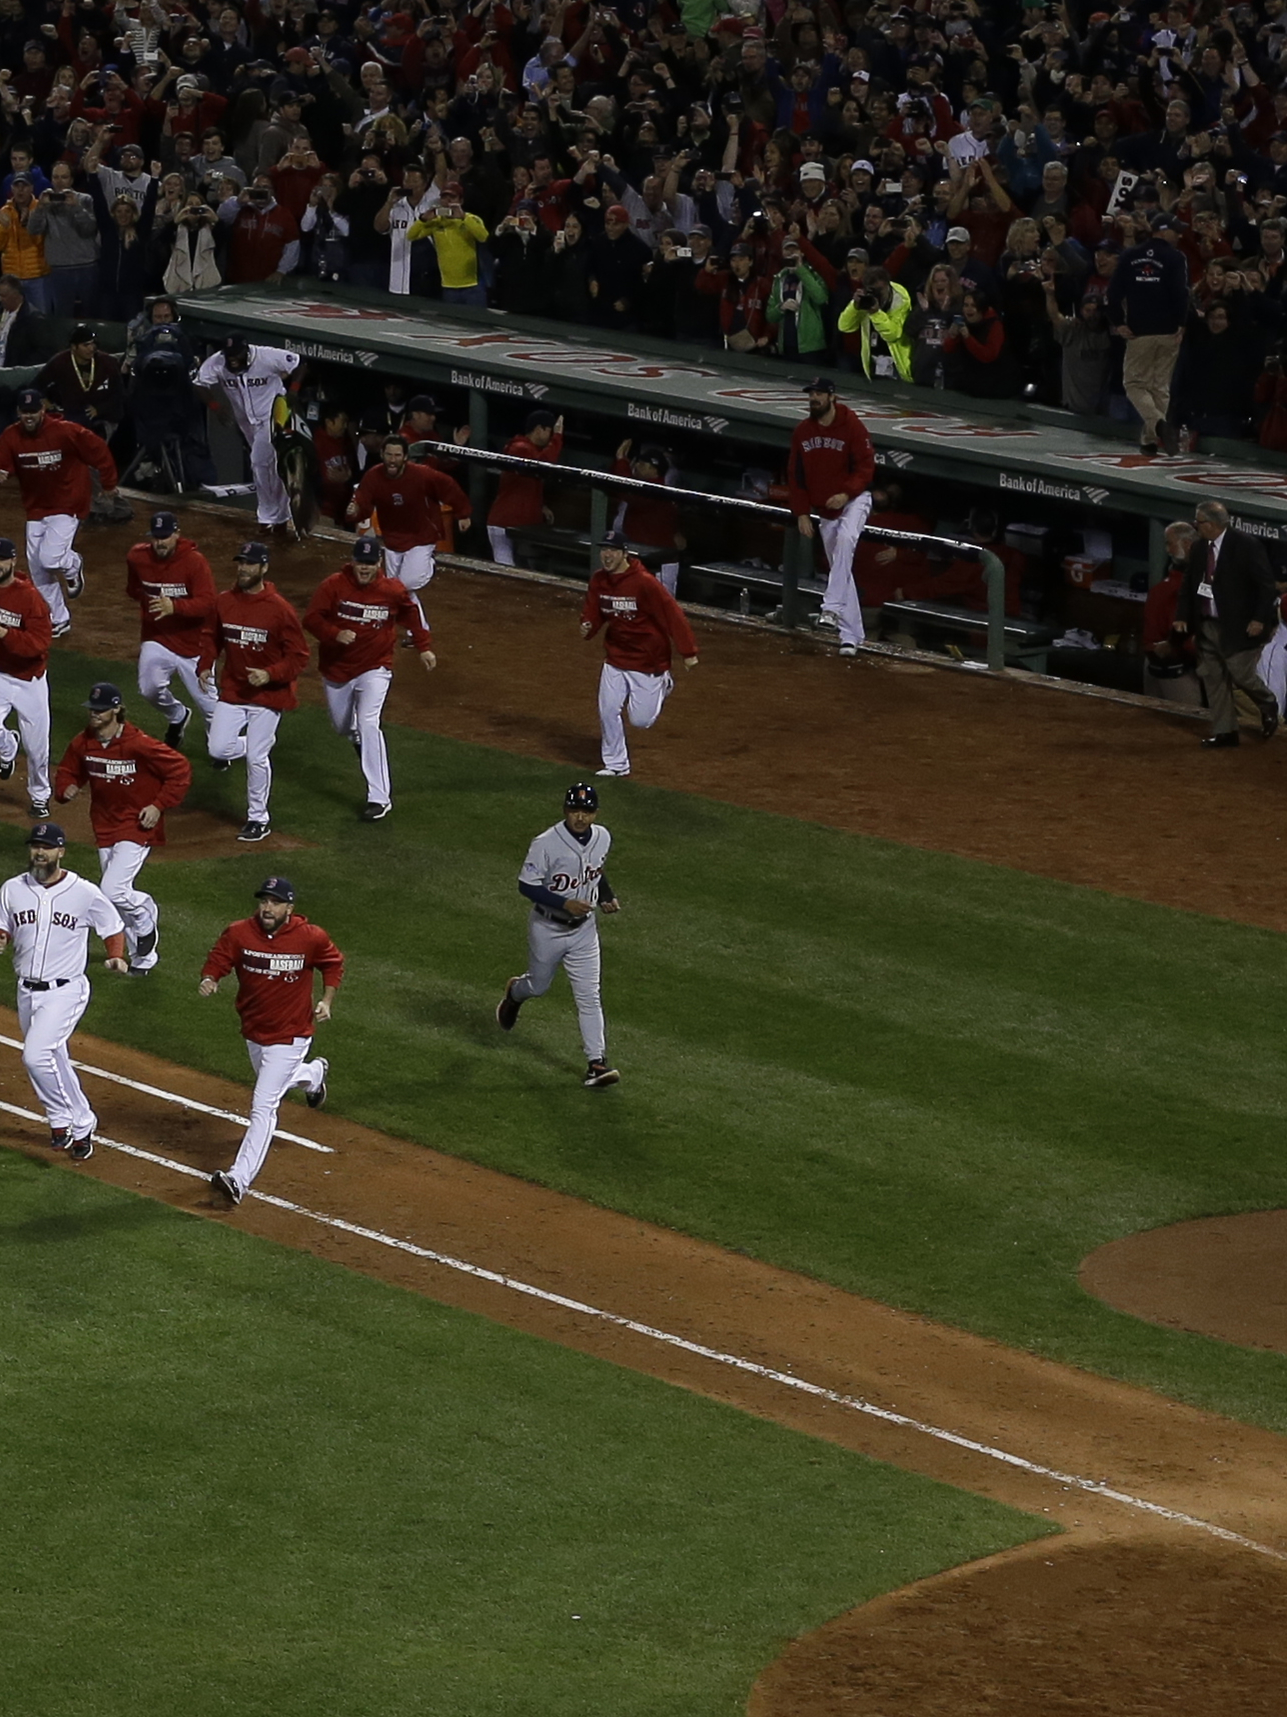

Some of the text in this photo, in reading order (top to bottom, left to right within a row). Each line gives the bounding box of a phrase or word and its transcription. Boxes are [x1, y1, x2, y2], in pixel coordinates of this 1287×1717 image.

[115, 187, 146, 199] BOSTO
[284, 338, 355, 364] Bank of America
[451, 370, 523, 396] Bank of America
[627, 402, 702, 430] Bank of America
[999, 472, 1081, 501] Bank of America
[1234, 516, 1280, 540] America
[1070, 563, 1084, 583] G
[51, 911, 79, 931] SOX
[269, 958, 305, 972] BASEBALL
